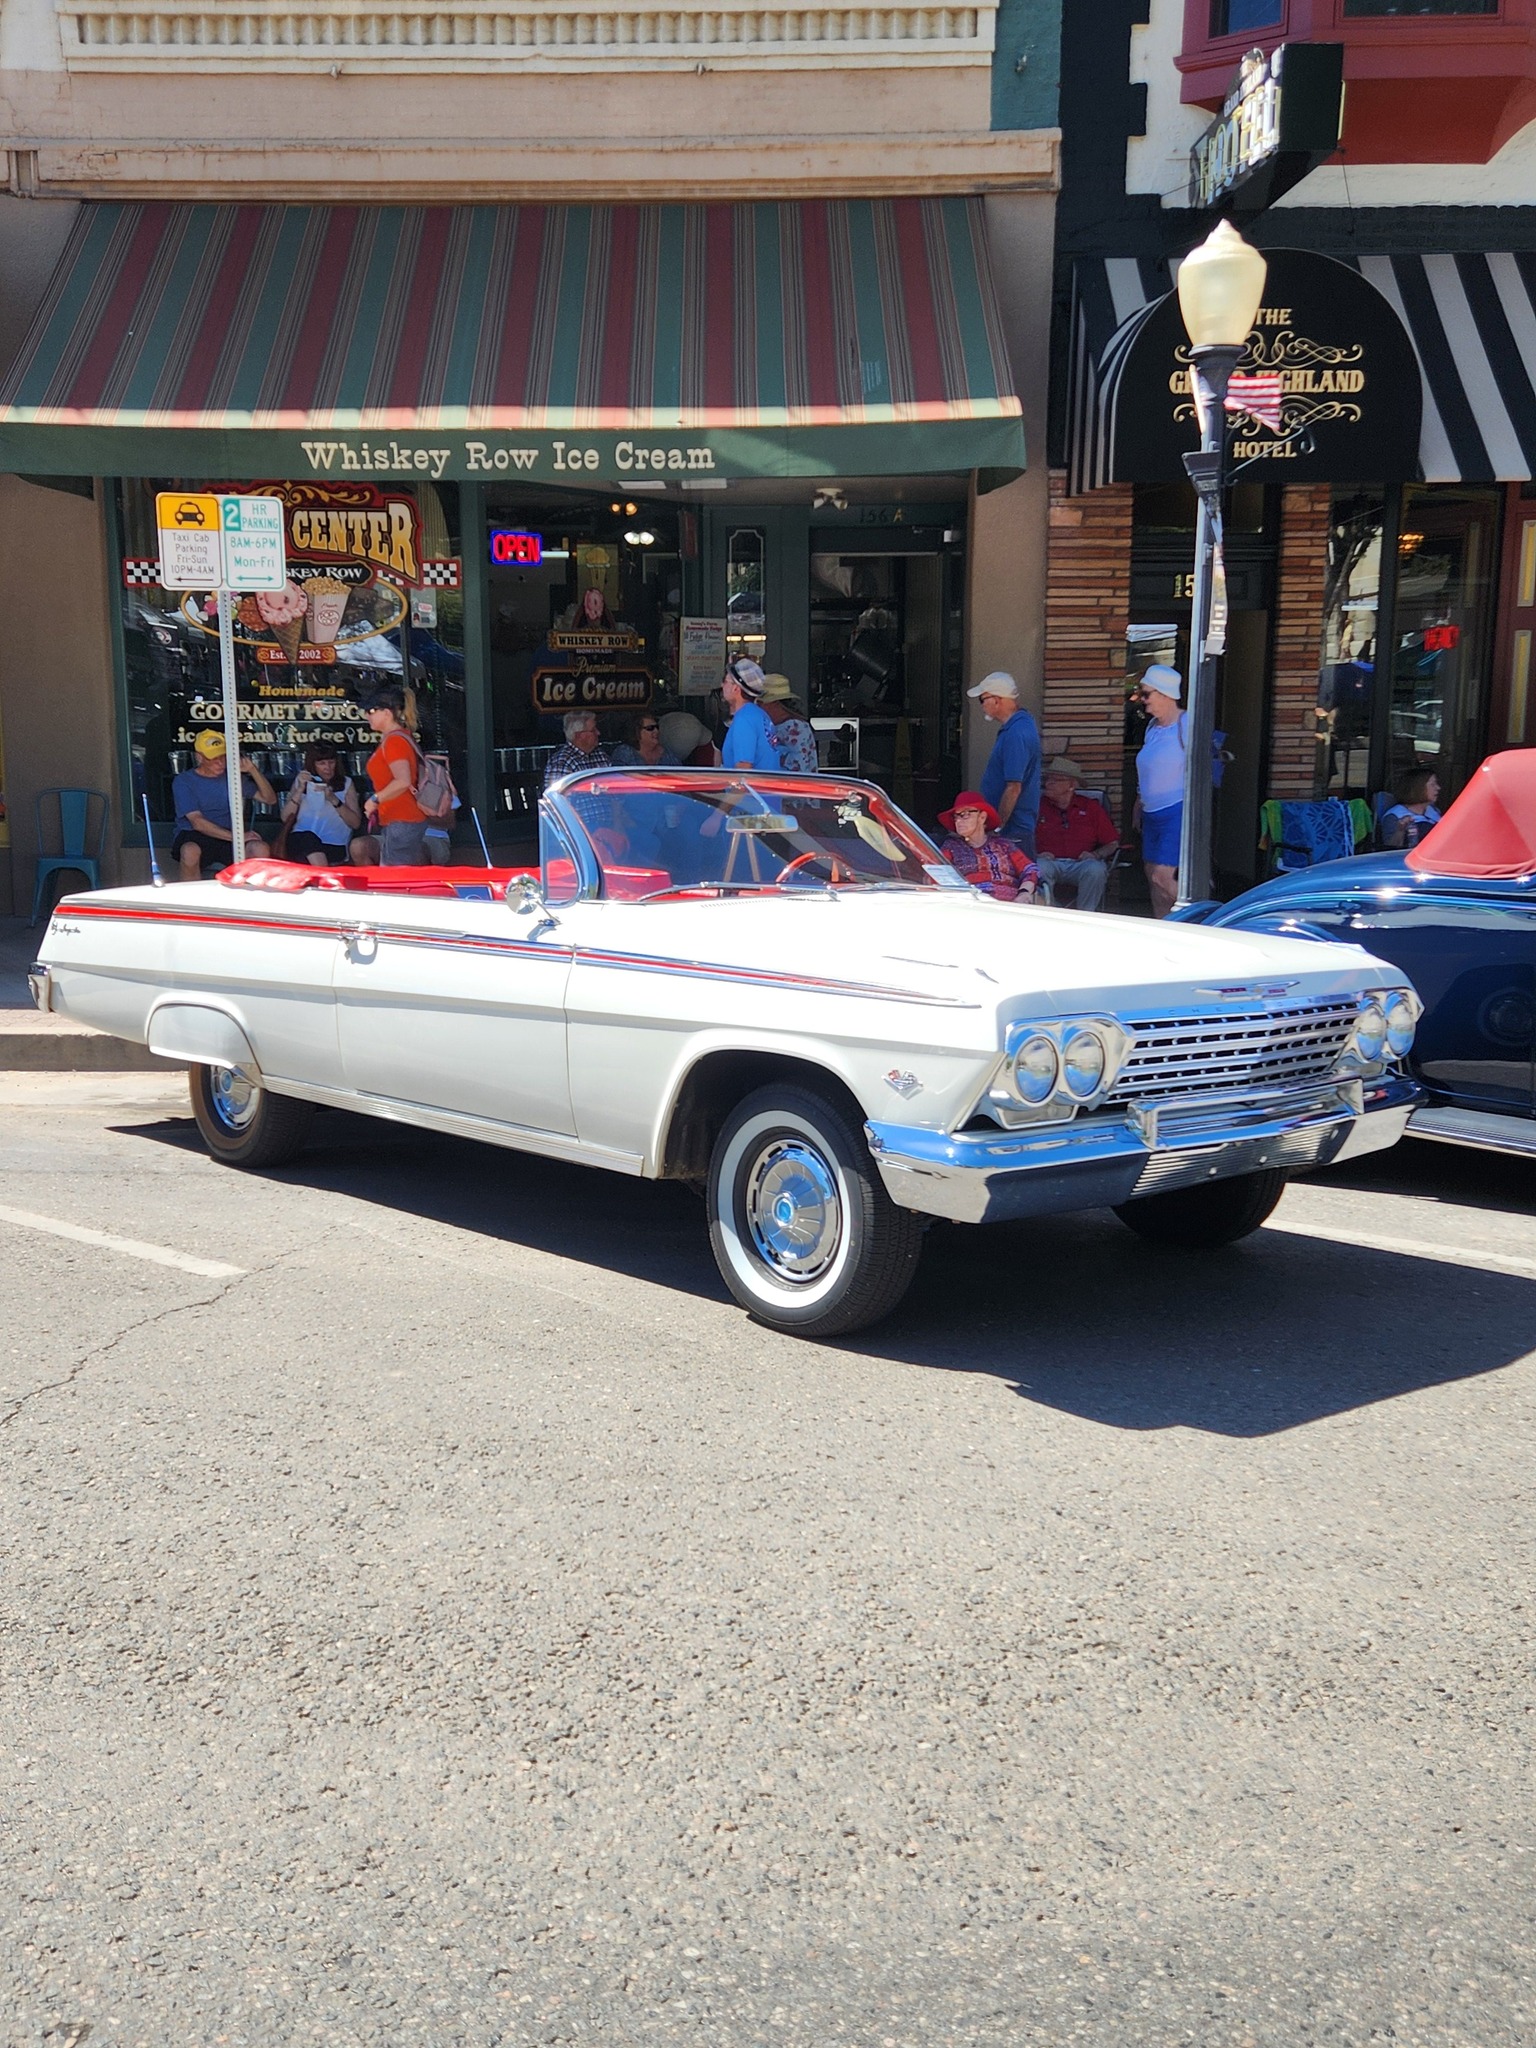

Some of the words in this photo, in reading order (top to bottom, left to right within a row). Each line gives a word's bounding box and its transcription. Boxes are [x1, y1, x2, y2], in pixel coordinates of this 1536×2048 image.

[1255, 308, 1292, 325] THE
[1255, 369, 1365, 393] GHLAND
[1233, 441, 1297, 458] HOTEL
[301, 441, 450, 478] Whiskey
[465, 441, 539, 470] Row
[552, 441, 599, 470] Ice
[615, 441, 715, 470] Cream
[224, 503, 239, 527] 2
[252, 504, 267, 515] HR
[242, 517, 279, 529] PARKING
[172, 533, 190, 542] Taxi
[194, 533, 210, 543] Cab
[230, 537, 277, 549] 8AM-6PM
[291, 503, 416, 579] CENTER
[175, 544, 208, 555] Parking
[493, 534, 540, 562] OPEN
[177, 554, 208, 564] Fri-Sun
[234, 556, 275, 568] Mon-Fri
[171, 564, 215, 574] 10PM-4AM
[285, 567, 322, 579] SKEY
[325, 567, 363, 579] ROW
[1173, 574, 1195, 598] 15
[558, 636, 604, 646] WHISKEY
[608, 636, 628, 646] ROW
[299, 650, 322, 660] 2002
[572, 656, 617, 677] Premium
[259, 685, 345, 698] Homemade
[542, 678, 576, 701] Ice
[582, 676, 645, 701] Cream
[190, 703, 299, 720] GORMET
